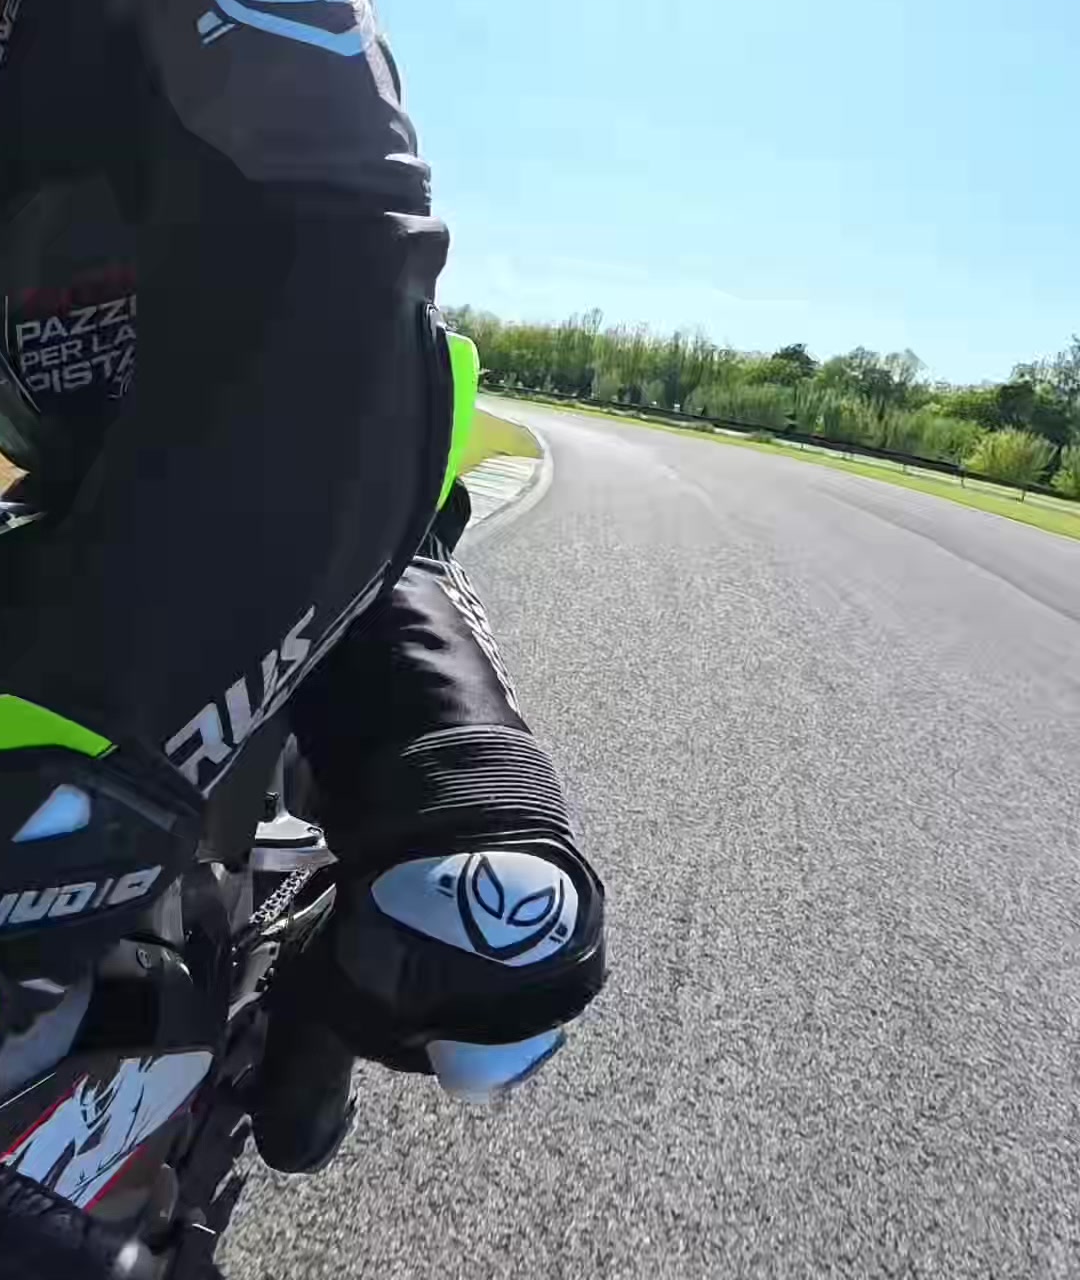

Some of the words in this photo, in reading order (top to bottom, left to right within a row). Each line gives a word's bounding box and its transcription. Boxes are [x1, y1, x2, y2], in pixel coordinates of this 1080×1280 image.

[16, 295, 137, 352] PAZZI
[21, 339, 83, 373] PER
[93, 324, 137, 352] LA
[165, 605, 316, 786] RUS
